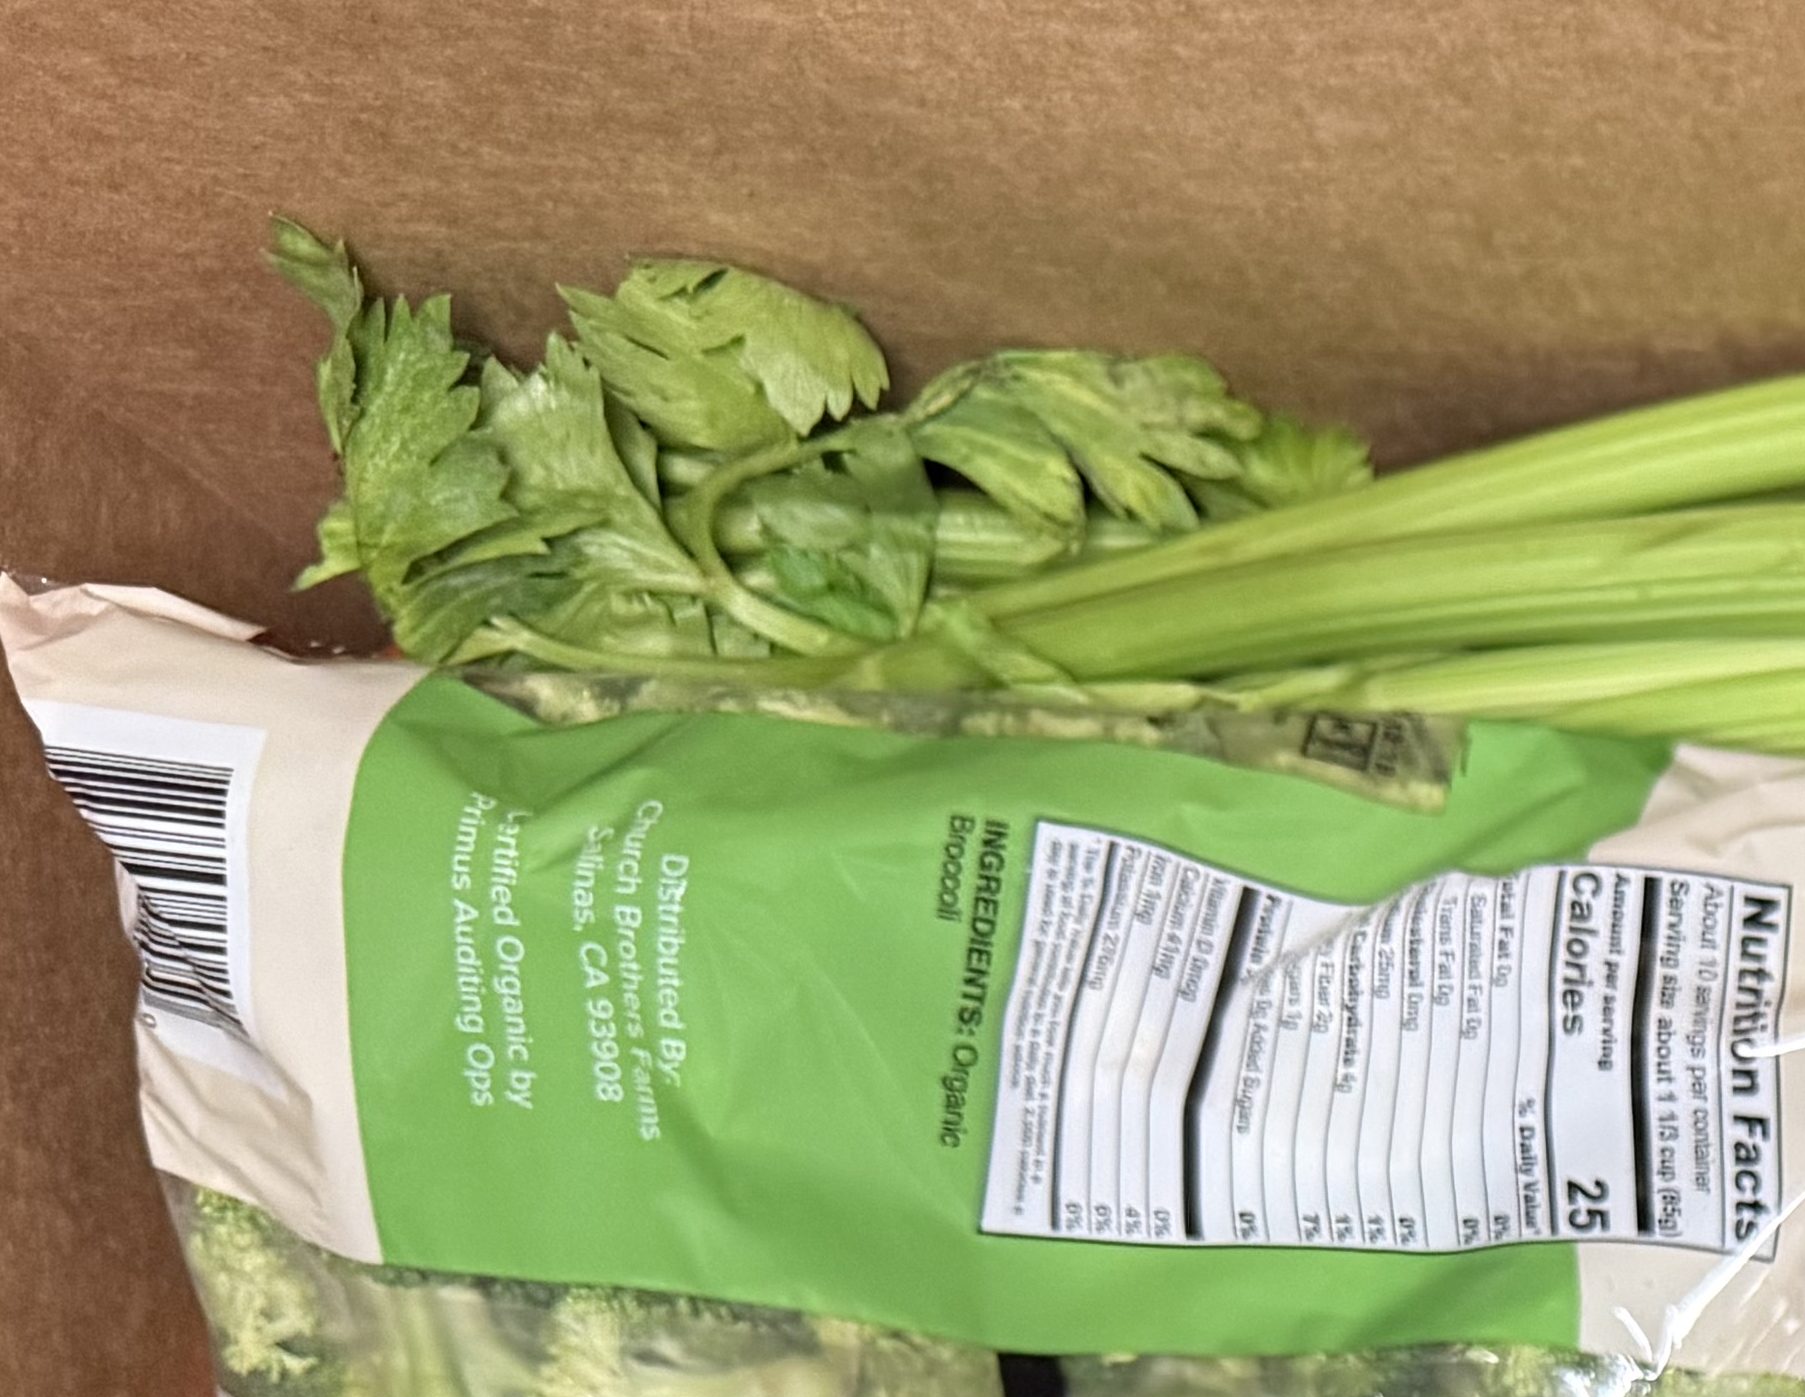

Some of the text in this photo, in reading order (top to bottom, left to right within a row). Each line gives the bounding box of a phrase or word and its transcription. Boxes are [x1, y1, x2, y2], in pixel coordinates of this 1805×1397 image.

[936, 814, 974, 922] Broccoli
[451, 792, 497, 1106] Primus Auditing Ops
[658, 855, 690, 1029] Distributed
[1498, 926, 1513, 958] Fat
[1610, 873, 1632, 955] Amount
[1662, 880, 1690, 969] Serving
[1700, 884, 1723, 950] About
[493, 936, 532, 1061] Organic
[579, 942, 609, 988] CA
[614, 801, 663, 1141] Church Brothers Farms
[940, 819, 1010, 1149] INGREDIENTS: Organic
[1661, 974, 1680, 1008] size
[505, 1070, 537, 1109] by
[586, 997, 623, 1102] 93908
[1562, 871, 1610, 1232] Calories 25
[1657, 1019, 1676, 1083] about
[1687, 1065, 1711, 1101] per
[1731, 895, 1781, 1243] Nutrition Facts
[1518, 1126, 1538, 1177] Daily
[1656, 1149, 1676, 1183] cup
[1692, 1109, 1712, 1194] container
